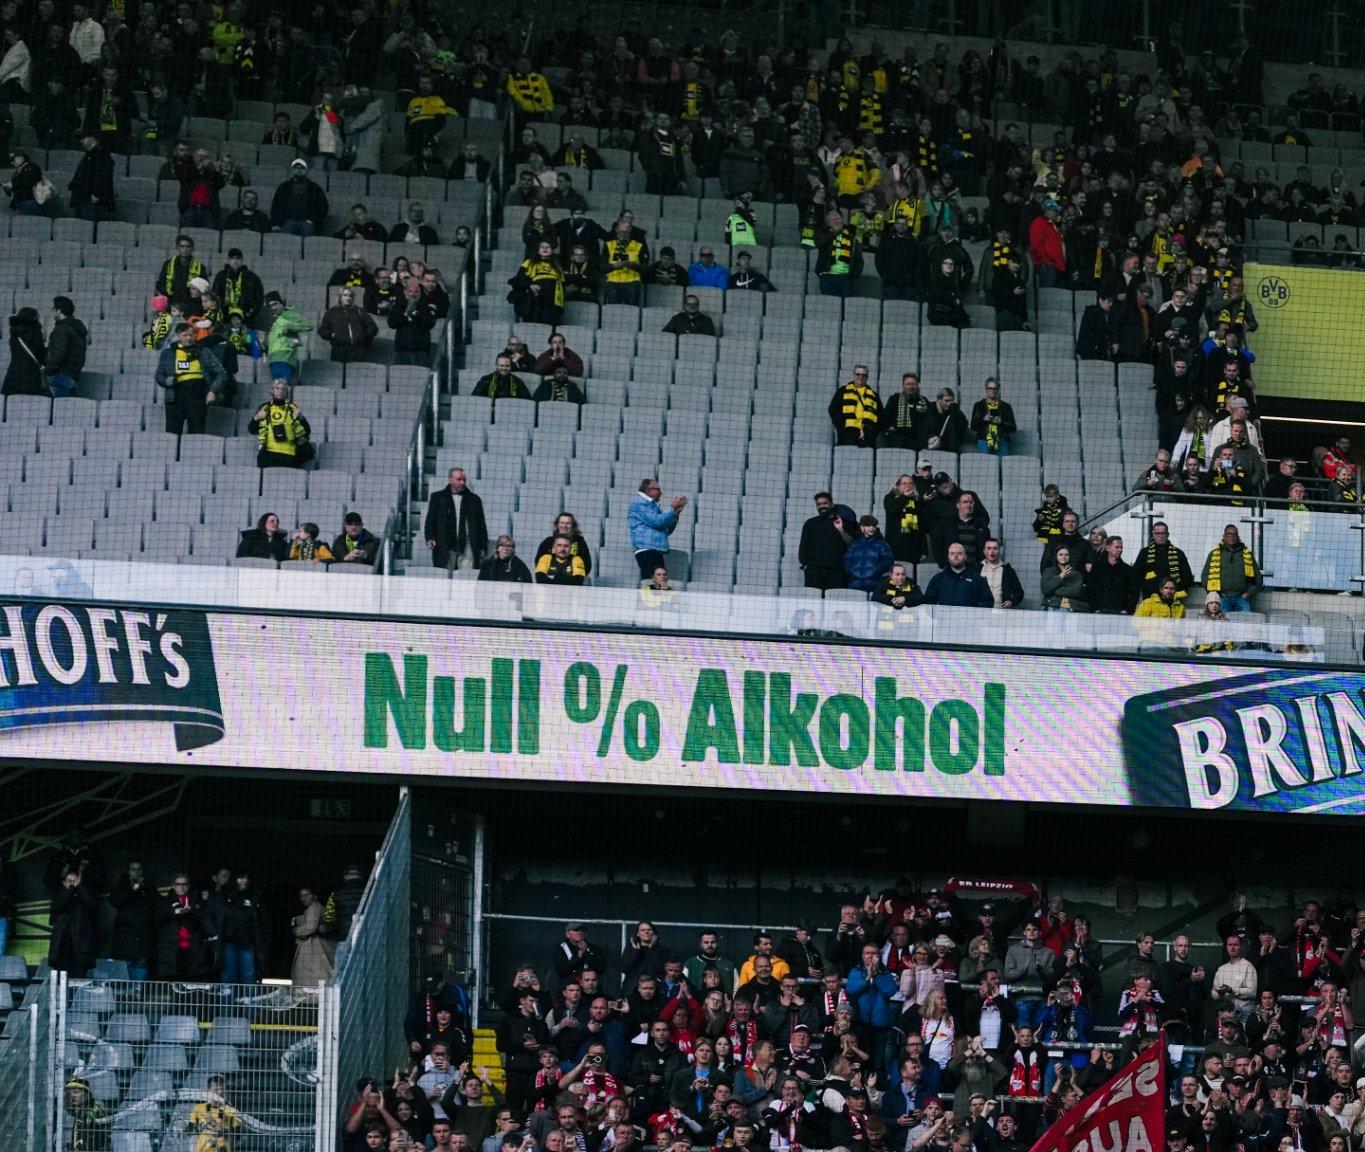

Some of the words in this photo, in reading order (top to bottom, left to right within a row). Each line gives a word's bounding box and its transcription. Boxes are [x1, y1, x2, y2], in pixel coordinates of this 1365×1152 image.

[364, 652, 541, 755] Null
[564, 661, 661, 762] %
[682, 667, 1006, 776] Alkohol
